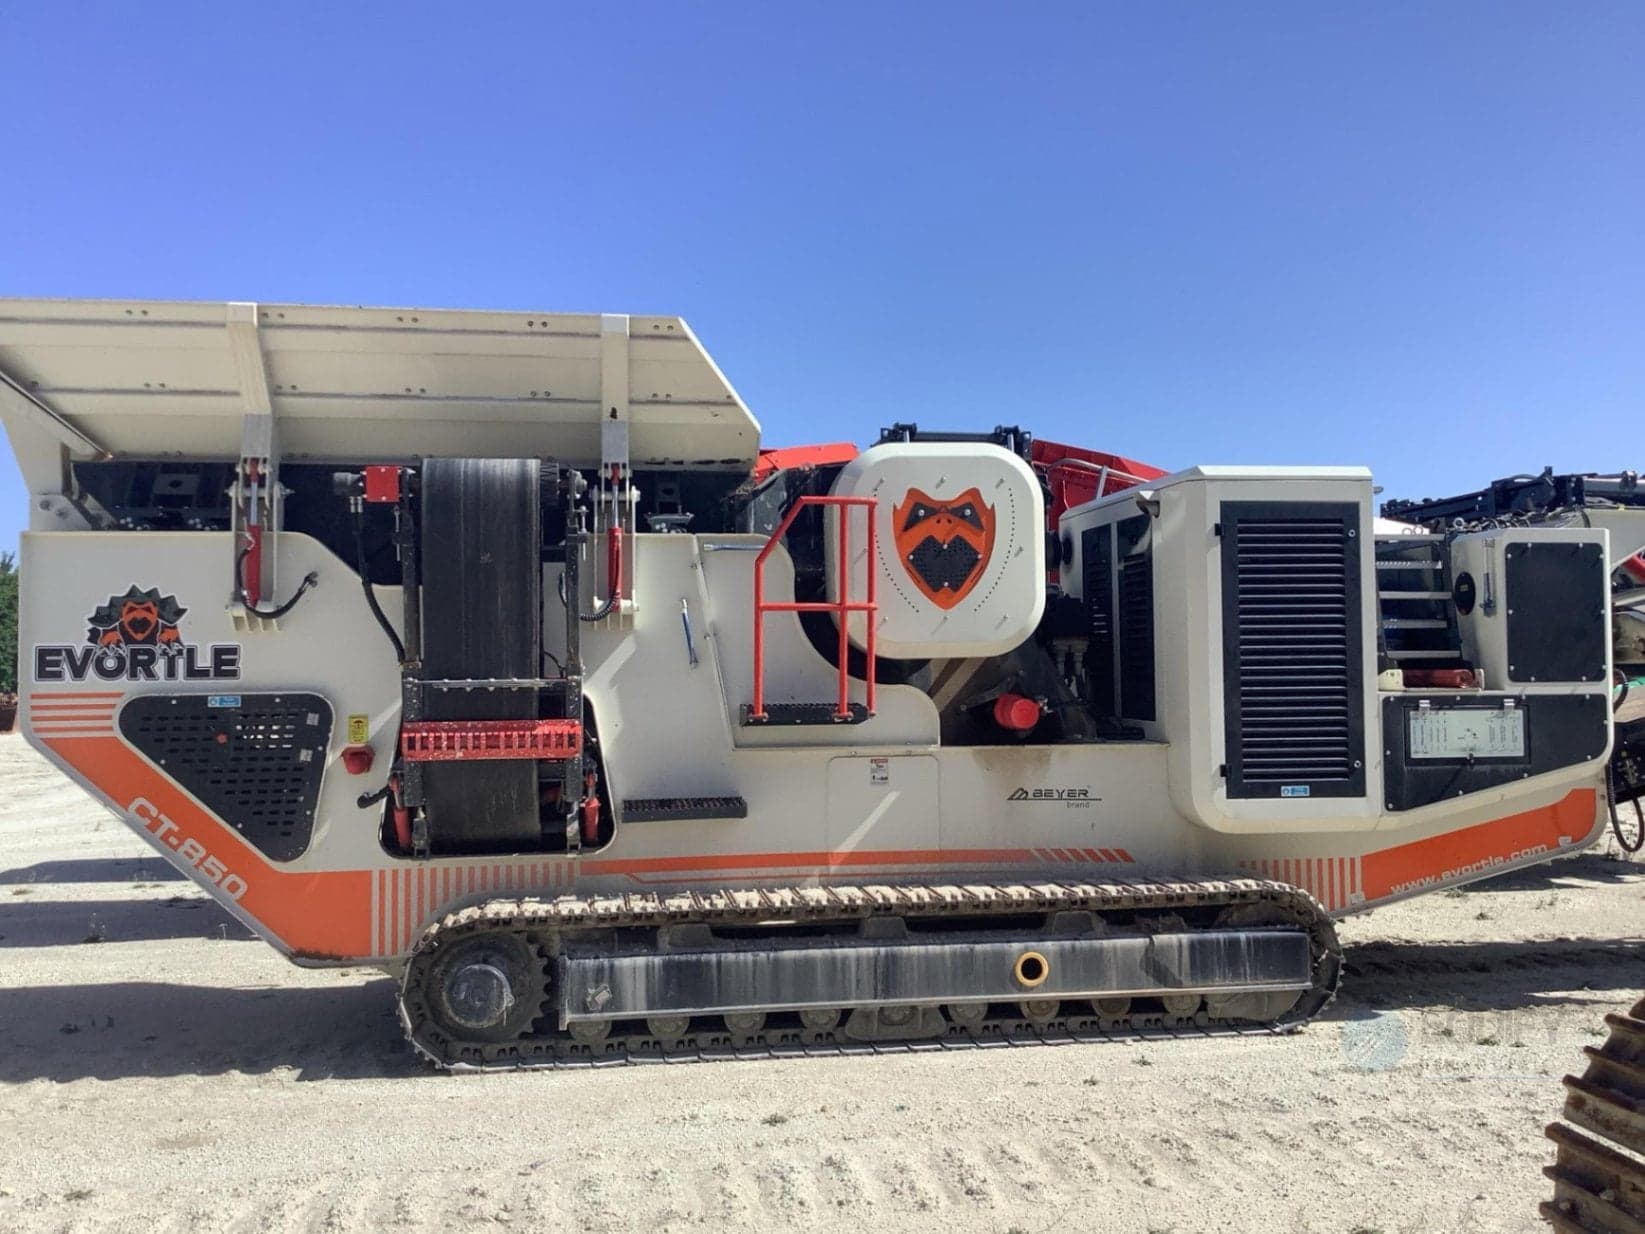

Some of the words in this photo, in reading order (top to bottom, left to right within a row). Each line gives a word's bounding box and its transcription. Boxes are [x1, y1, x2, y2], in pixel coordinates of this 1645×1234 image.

[35, 645, 241, 681] EVORTLE
[1032, 788, 1089, 799] BEYER
[127, 797, 248, 900] CT-850
[1390, 843, 1548, 895] www.evortle.com
